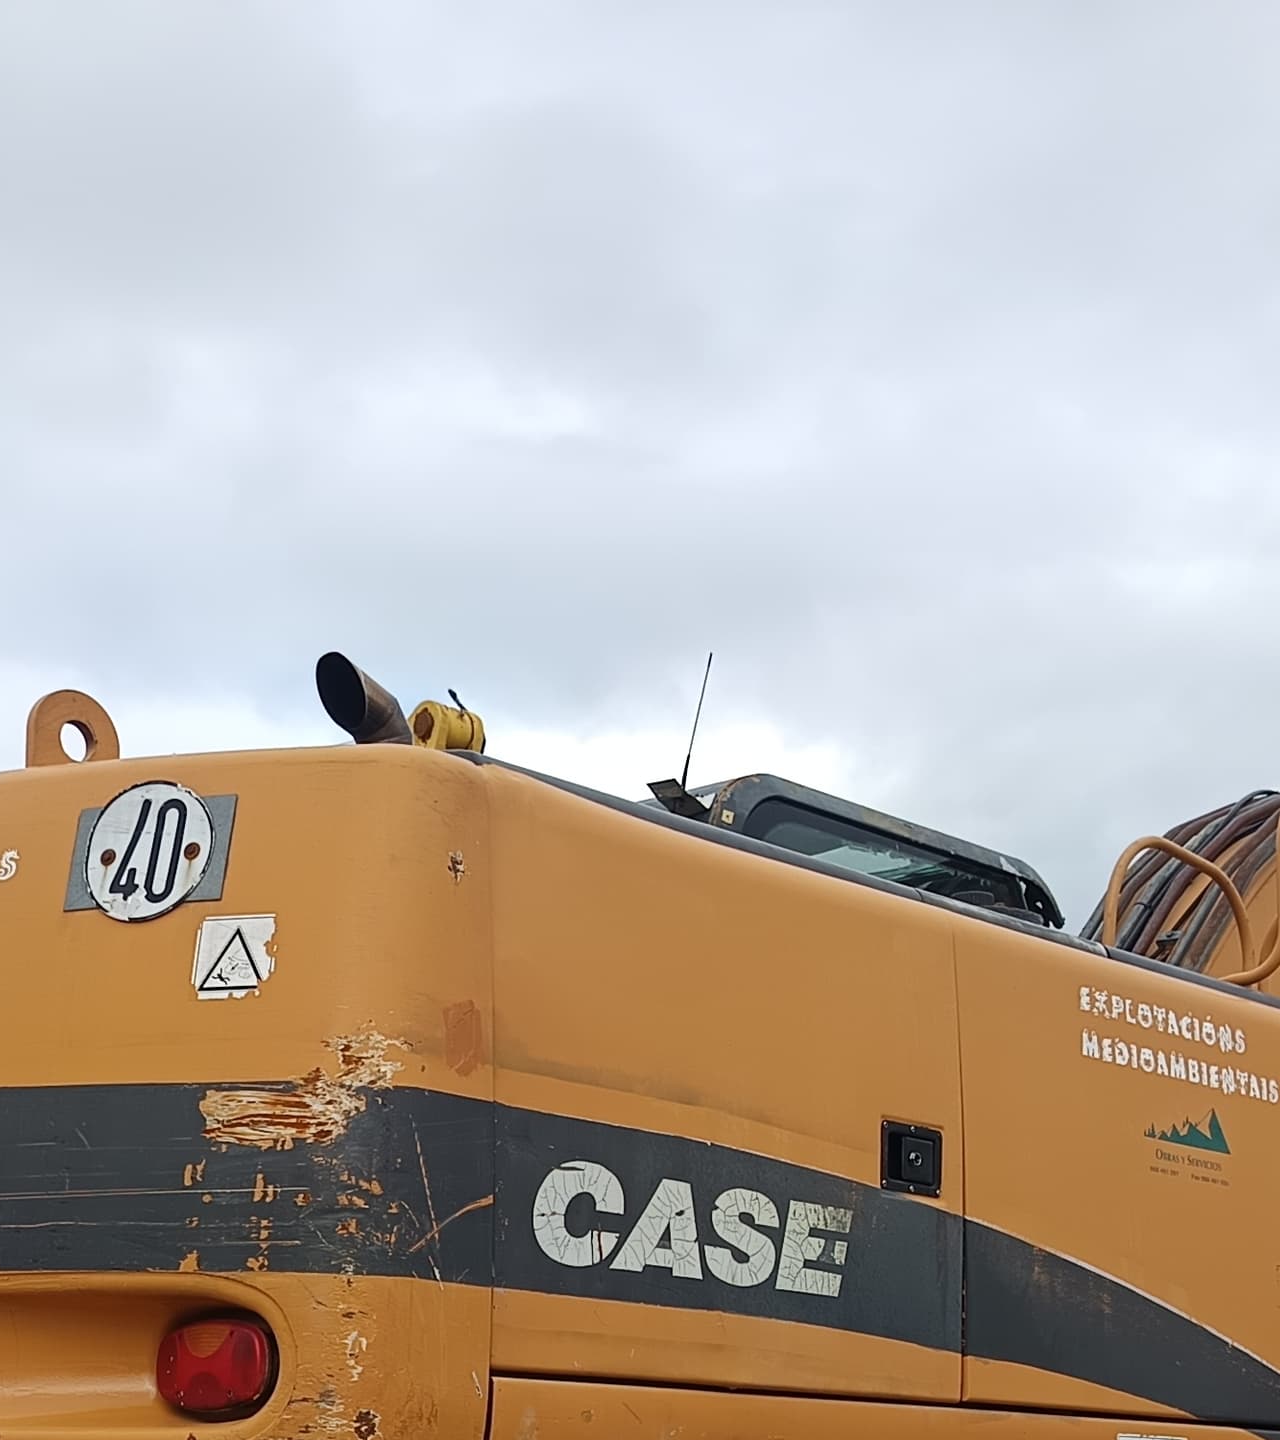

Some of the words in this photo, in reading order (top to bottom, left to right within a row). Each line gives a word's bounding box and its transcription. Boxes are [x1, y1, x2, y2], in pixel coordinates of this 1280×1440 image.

[108, 798, 188, 904] 40
[1081, 1028, 1280, 1104] MEDIOAMBIENTAIS
[532, 1160, 854, 1298] CASE
